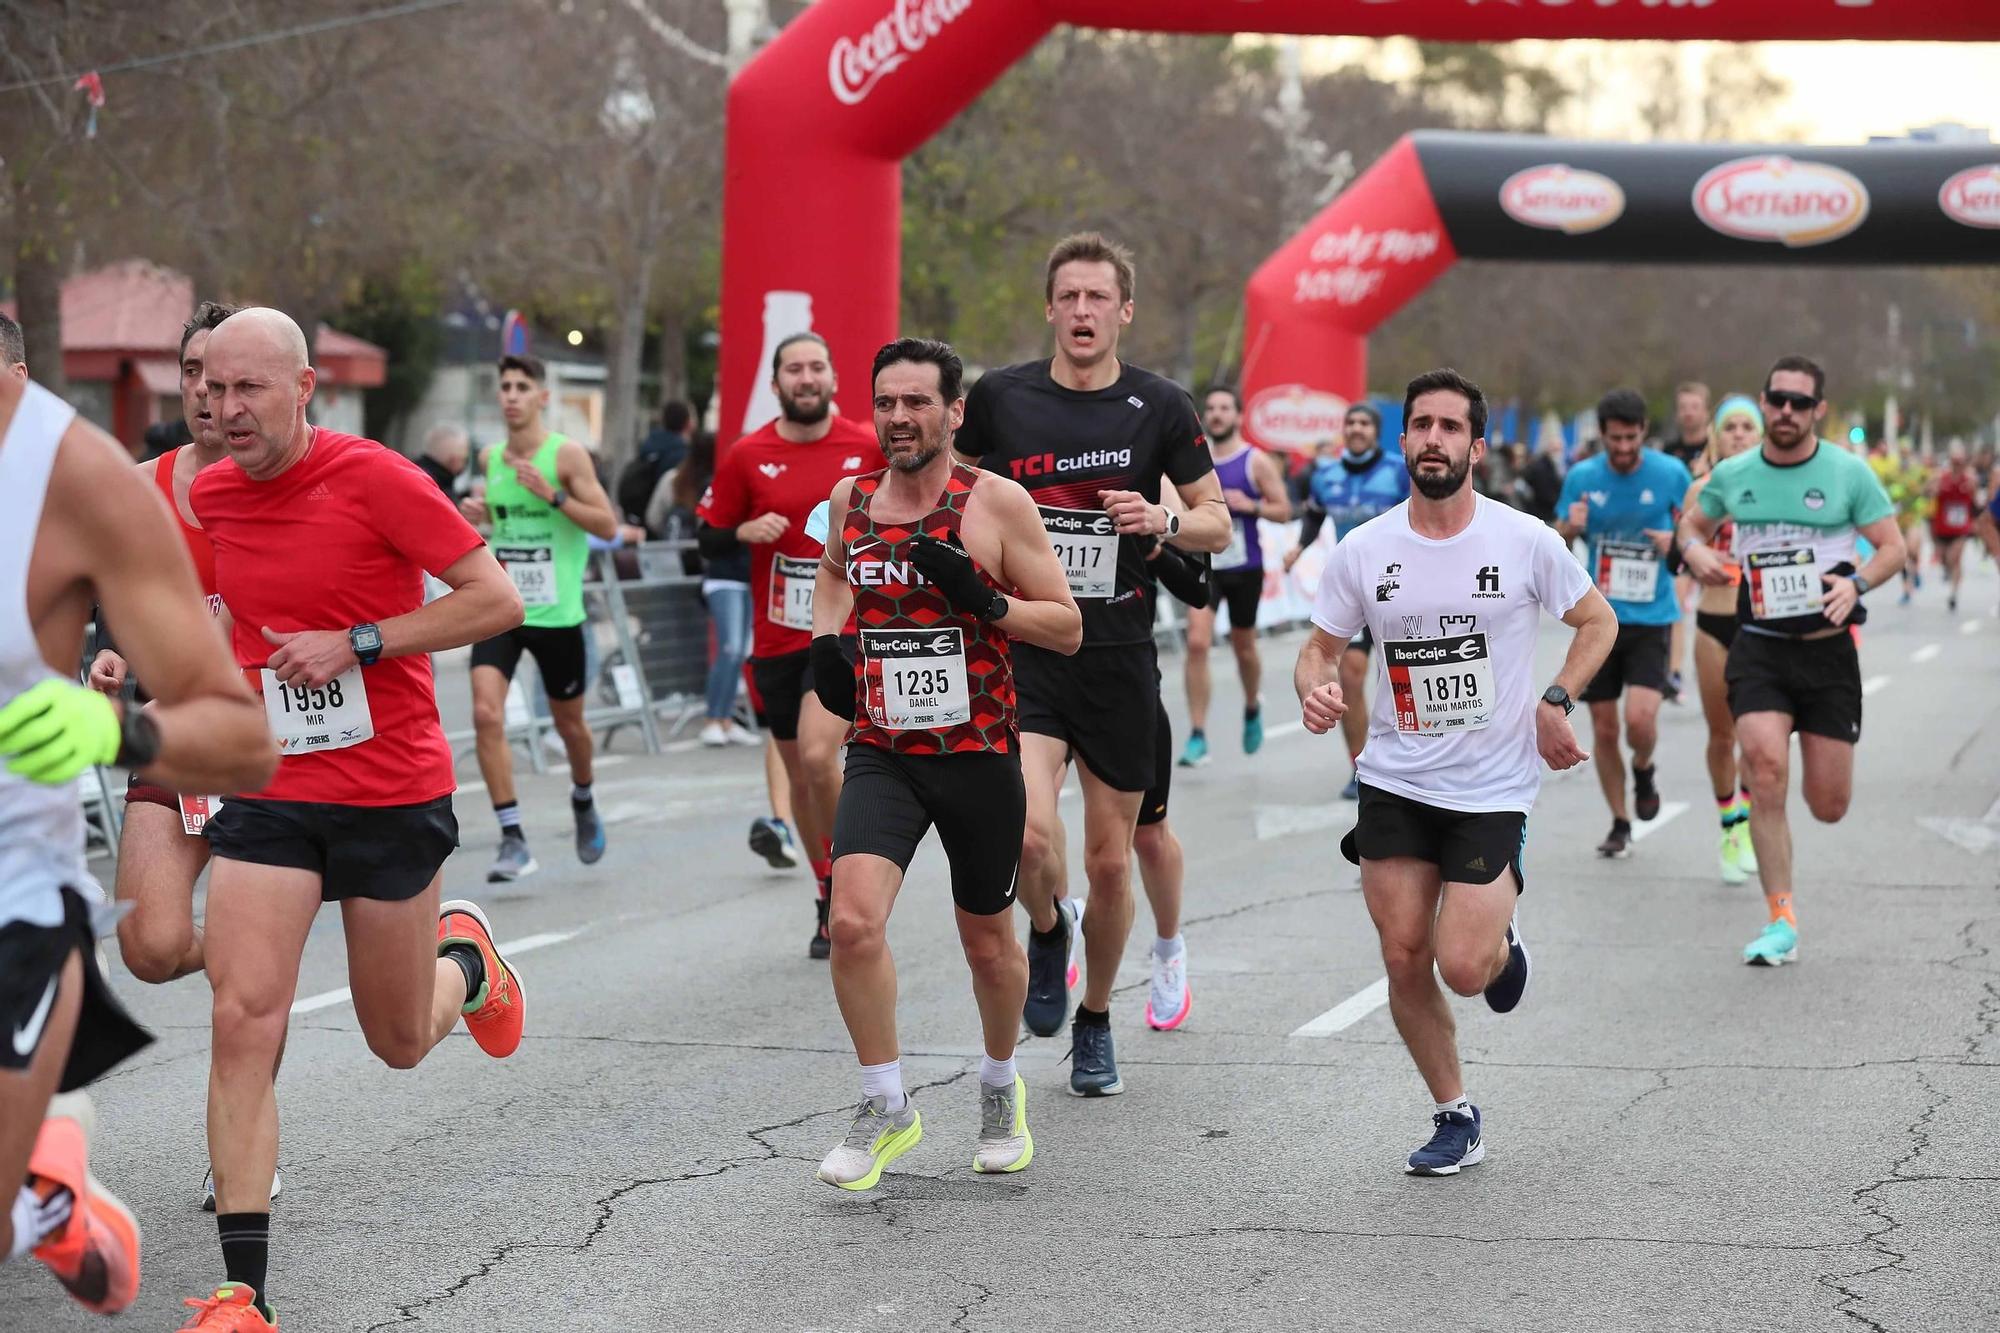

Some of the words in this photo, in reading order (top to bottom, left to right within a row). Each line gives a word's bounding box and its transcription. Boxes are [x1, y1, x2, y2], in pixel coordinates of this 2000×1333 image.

[1720, 180, 1848, 217] Serrano
[1009, 453, 1055, 480] TCI
[1056, 449, 1131, 471] cutting
[1043, 517, 1083, 531] erCaja
[1053, 543, 1102, 568] 2117
[845, 561, 934, 586] KENY
[1066, 569, 1087, 578] KAMIL
[1475, 566, 1499, 592] fi
[1771, 573, 1808, 593] 1314
[793, 588, 812, 607] 17
[1402, 616, 1422, 635] XV
[871, 639, 921, 653] iberCaja
[1395, 647, 1447, 660] iberCaja
[894, 669, 949, 696] 1235
[1423, 673, 1478, 701] 1879
[278, 679, 344, 713] 1958
[909, 698, 939, 708] DANIEL
[1426, 703, 1448, 713] MANU
[1450, 699, 1483, 711] MARTOS
[306, 714, 325, 726] MIR
[1404, 711, 1414, 725] 01
[306, 735, 330, 745] 226ERS
[192, 813, 206, 827] 01
